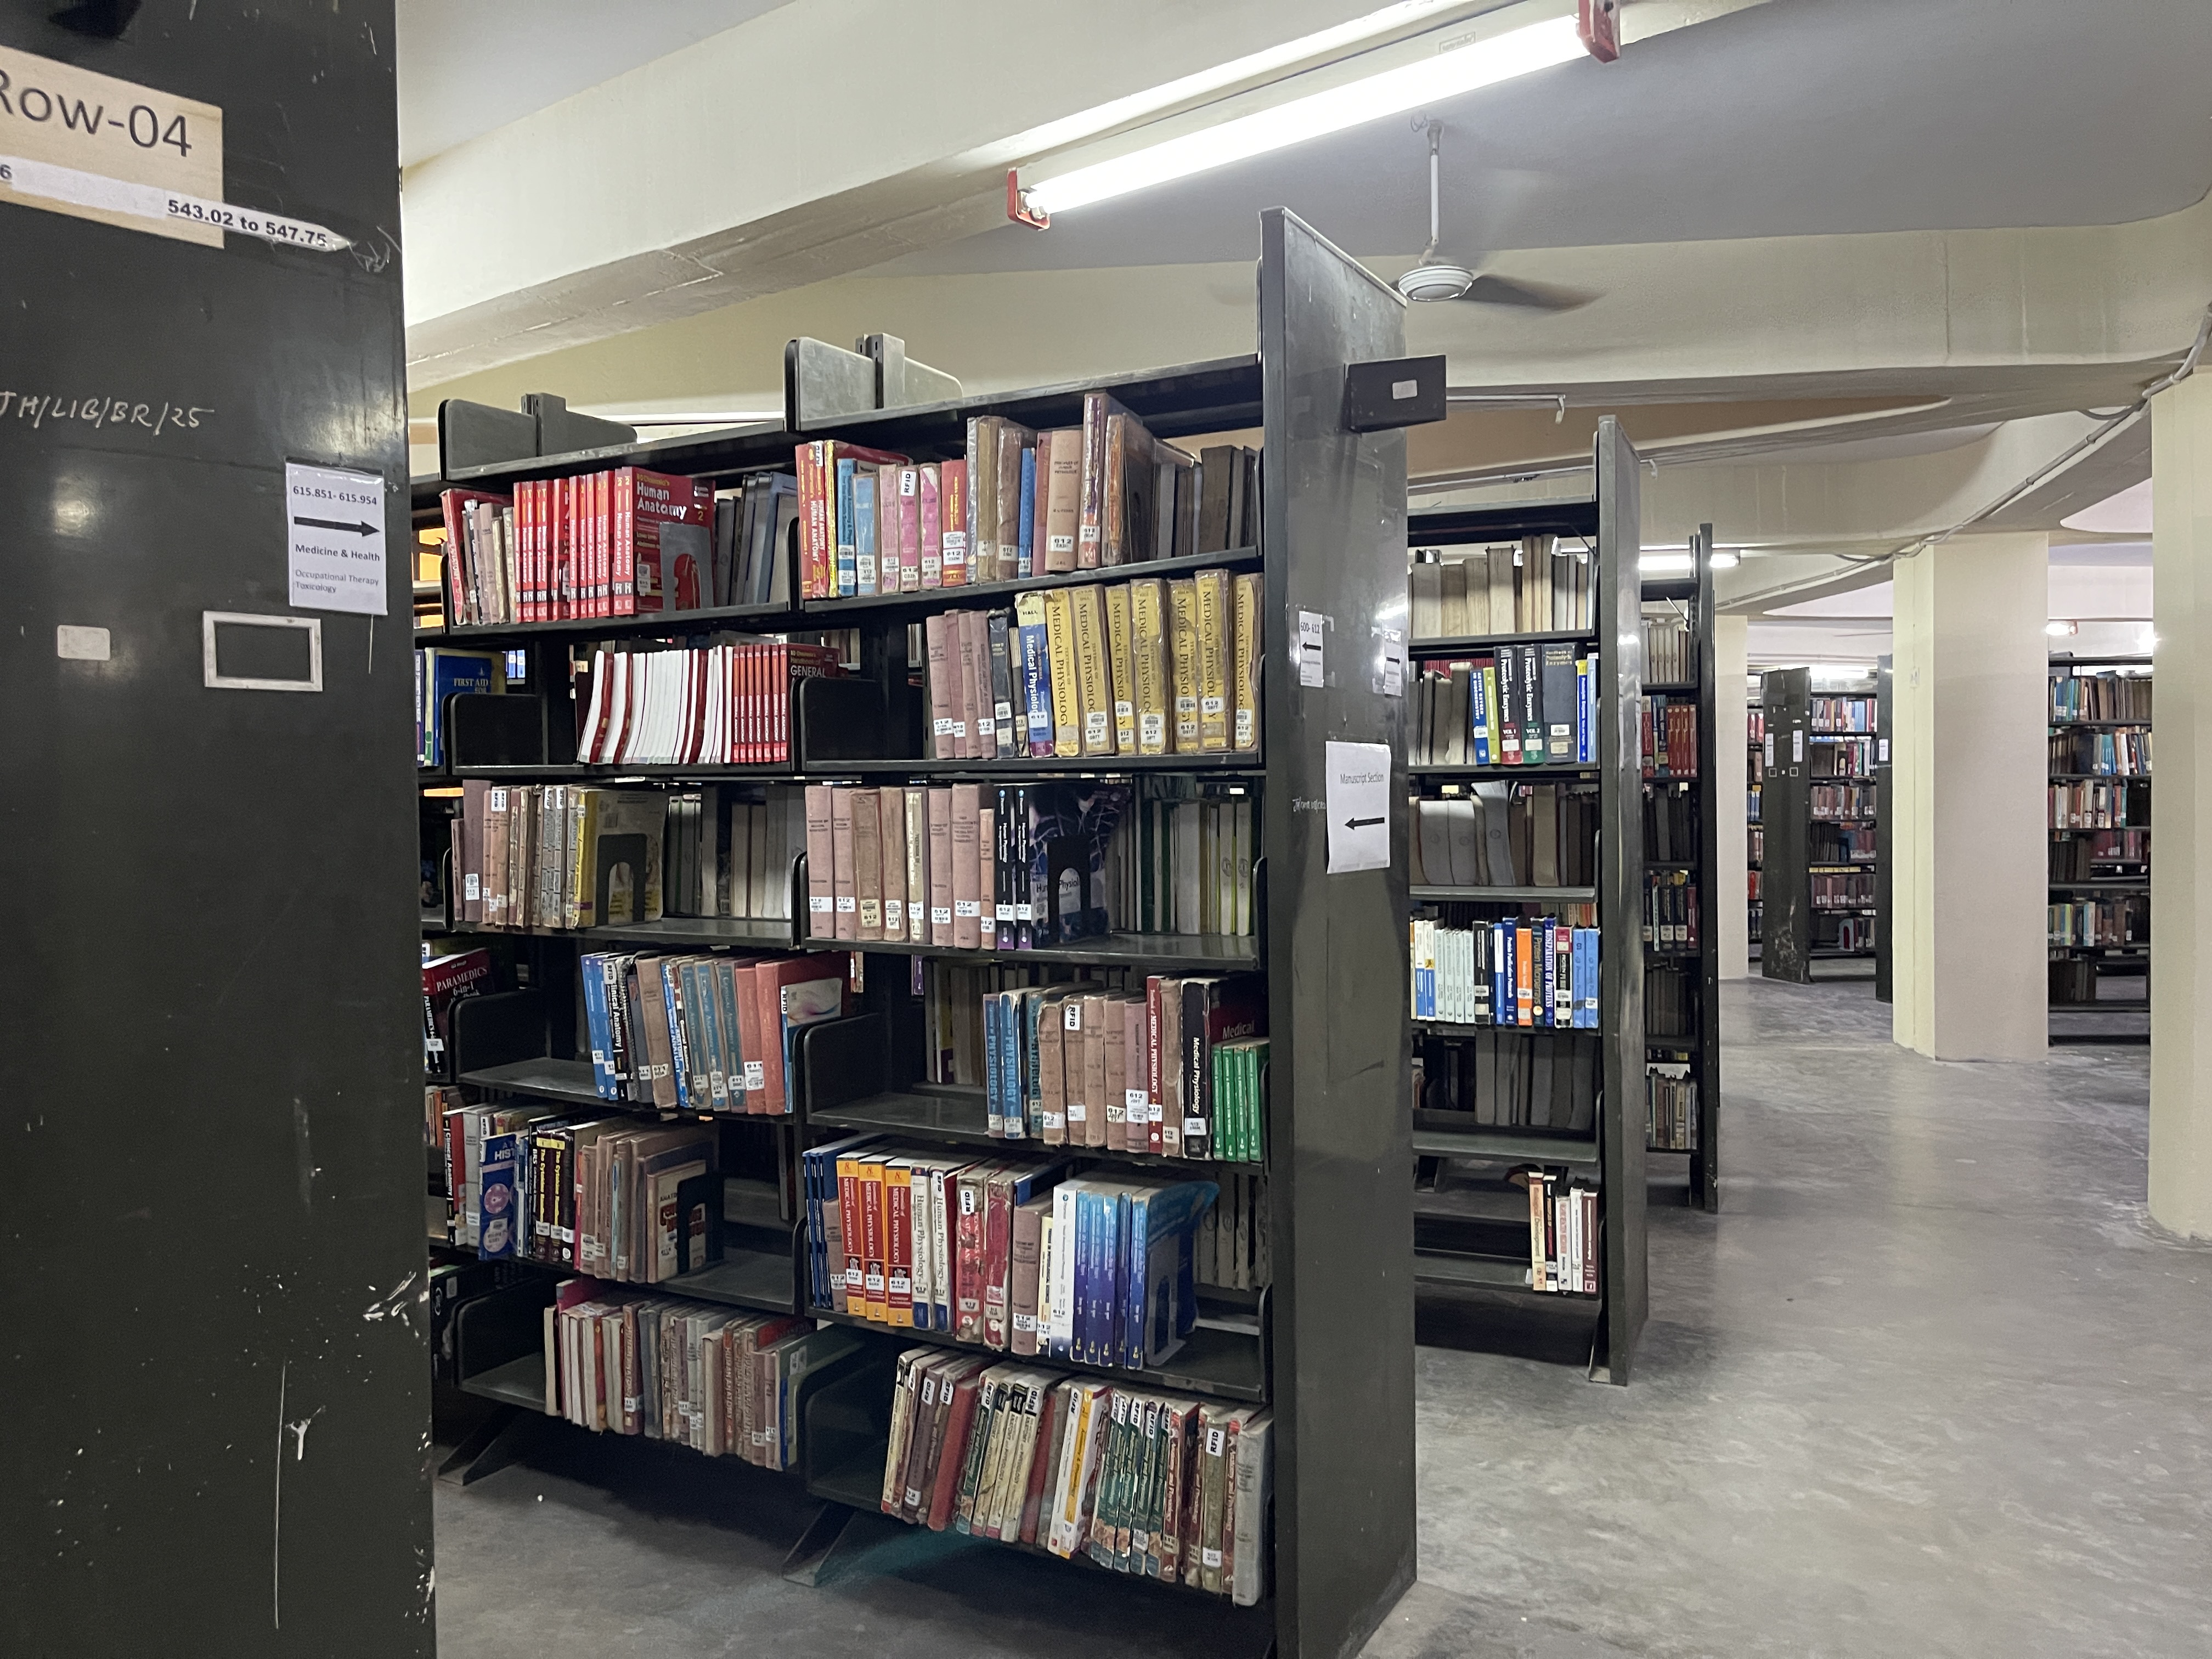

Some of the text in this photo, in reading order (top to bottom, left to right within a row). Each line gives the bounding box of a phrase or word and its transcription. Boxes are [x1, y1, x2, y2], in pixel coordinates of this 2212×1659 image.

[0, 69, 191, 157] Row-04
[168, 199, 233, 226] 543.02
[240, 217, 259, 231] to
[266, 221, 328, 246] 547.75
[339, 493, 377, 505] 615.954
[637, 481, 669, 500] Human
[637, 496, 687, 520] Anatomy
[698, 511, 703, 521] 2
[295, 544, 380, 562] Medicine & Health
[295, 569, 379, 586] Occupational Therapy
[295, 581, 336, 593] Toxicology
[1113, 603, 1123, 657] MEDICAL
[1138, 600, 1147, 650] MEDICAL
[1177, 598, 1189, 650] MEDICAL
[1203, 591, 1212, 647] MEDICAL
[1312, 624, 1320, 634] 612
[1052, 606, 1068, 726] MEDICAL PHYSIOLOGY
[1079, 603, 1096, 713] MEDICAL PHYSIOLOG
[454, 678, 474, 686] FIRST
[791, 665, 826, 678] GENERAL
[1026, 635, 1039, 713] Medical Physiolo
[1340, 772, 1384, 785] Manuscript Section
[1534, 937, 1542, 962] Protein
[436, 967, 488, 992] PARAMEDICS
[613, 1011, 622, 1048] Anatomy
[1222, 1020, 1255, 1040] Medical
[988, 1035, 997, 1102] PHYSIOLOGY
[1005, 1036, 1016, 1102] PHYSIOLOGY
[1192, 1070, 1200, 1114] Physiology
[660, 1193, 677, 1201] ANATO
[1028, 1390, 1036, 1410] RFID
